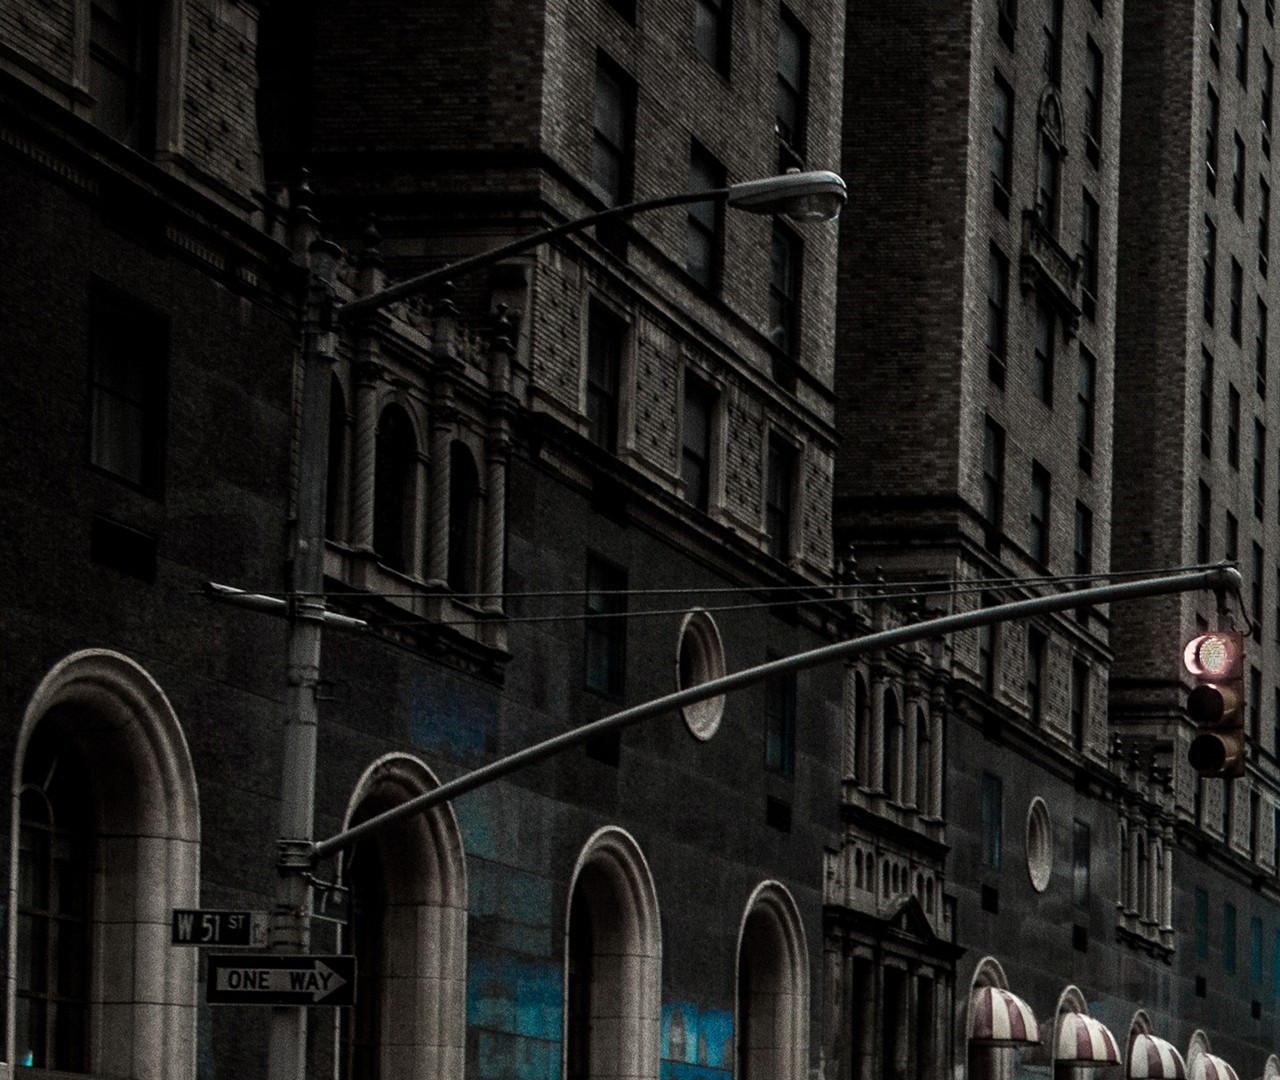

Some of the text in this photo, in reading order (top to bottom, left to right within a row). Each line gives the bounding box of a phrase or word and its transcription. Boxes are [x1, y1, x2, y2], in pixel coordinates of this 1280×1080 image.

[177, 912, 245, 942] W 51 ST
[228, 970, 334, 991] ONE WAY
